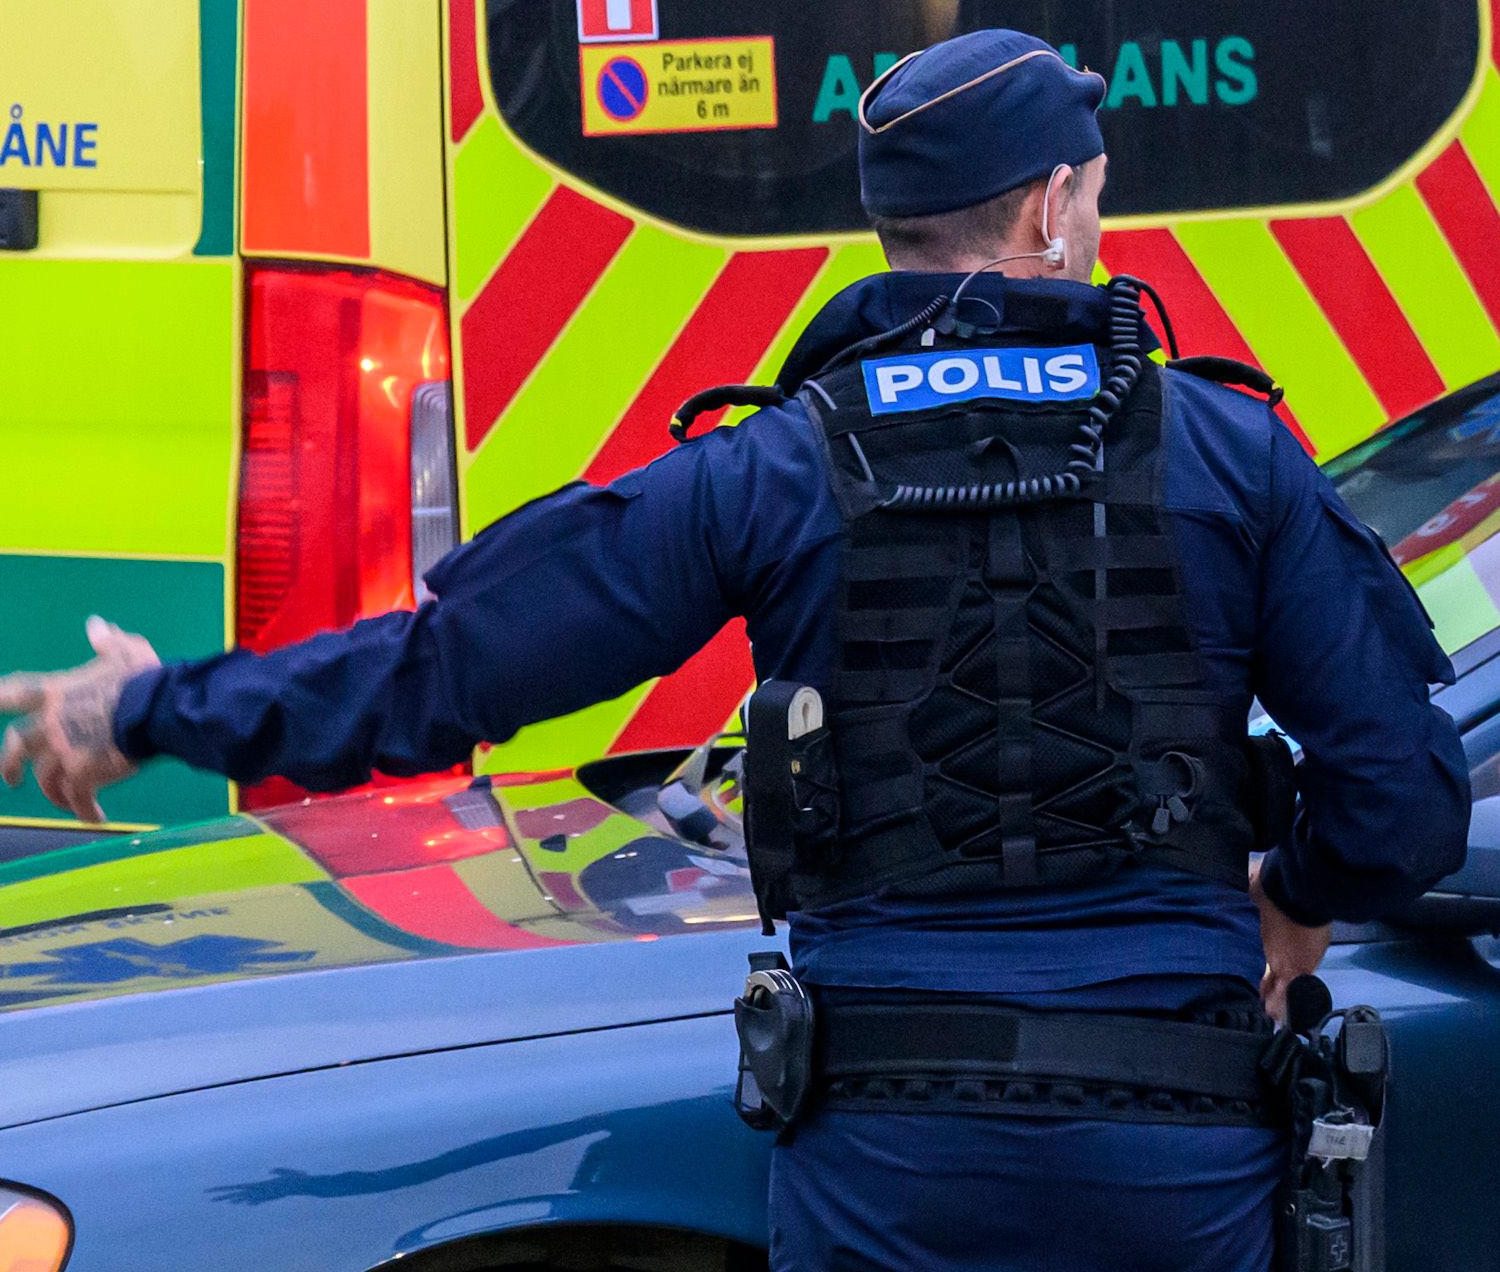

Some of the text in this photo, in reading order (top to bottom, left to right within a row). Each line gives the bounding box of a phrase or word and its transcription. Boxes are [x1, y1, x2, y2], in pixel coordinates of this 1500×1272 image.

[662, 50, 753, 74] Parkera ej
[658, 74, 760, 96] närmare än
[812, 36, 1258, 122] AANS
[697, 100, 729, 119] 6 m
[875, 354, 1088, 404] POLIS
